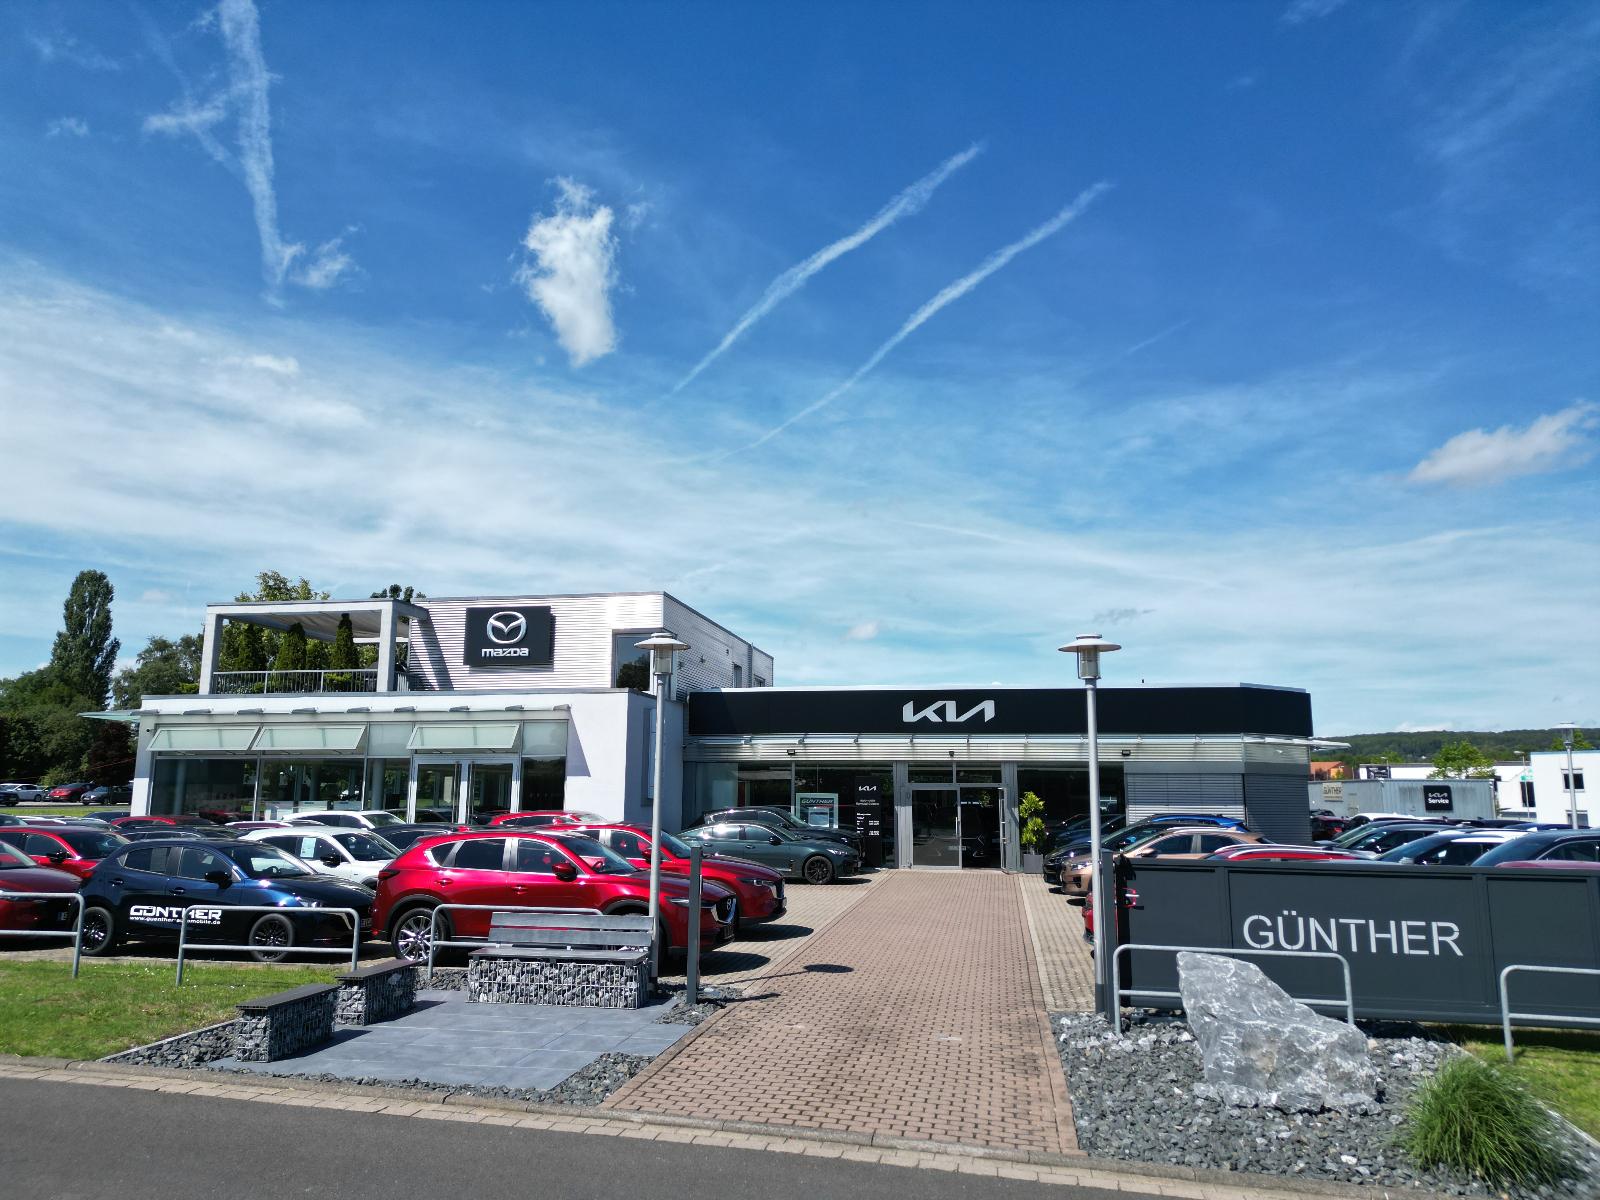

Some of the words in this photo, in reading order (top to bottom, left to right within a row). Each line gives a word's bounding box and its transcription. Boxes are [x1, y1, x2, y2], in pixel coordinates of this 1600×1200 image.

[481, 648, 529, 657] mazda
[903, 700, 995, 722] KIA
[1243, 910, 1464, 956] GÜNTHER
